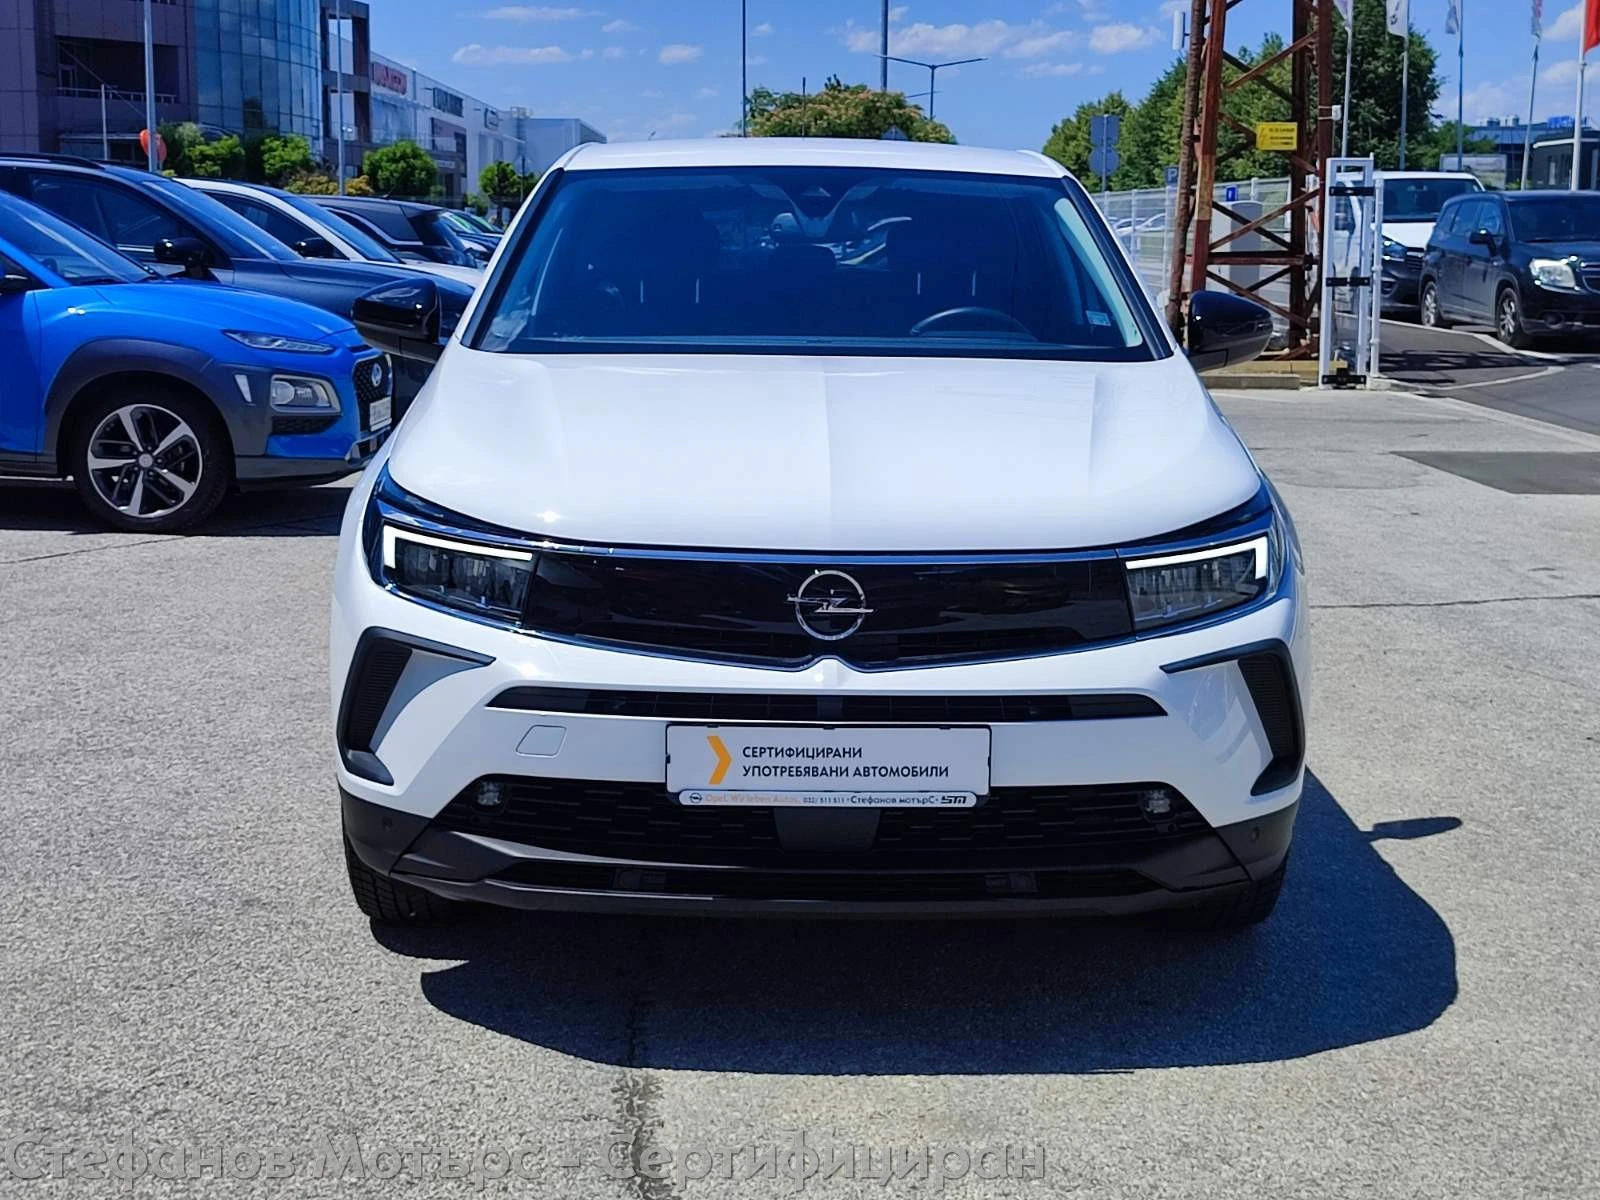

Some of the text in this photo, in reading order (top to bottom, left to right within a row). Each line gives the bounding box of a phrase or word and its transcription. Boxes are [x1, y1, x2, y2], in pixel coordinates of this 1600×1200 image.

[742, 746, 863, 760] СЕРТИФИЦИРАНИ
[742, 765, 950, 778] УПОТРЕБЯВАНИ АВТОМОБИЛИ
